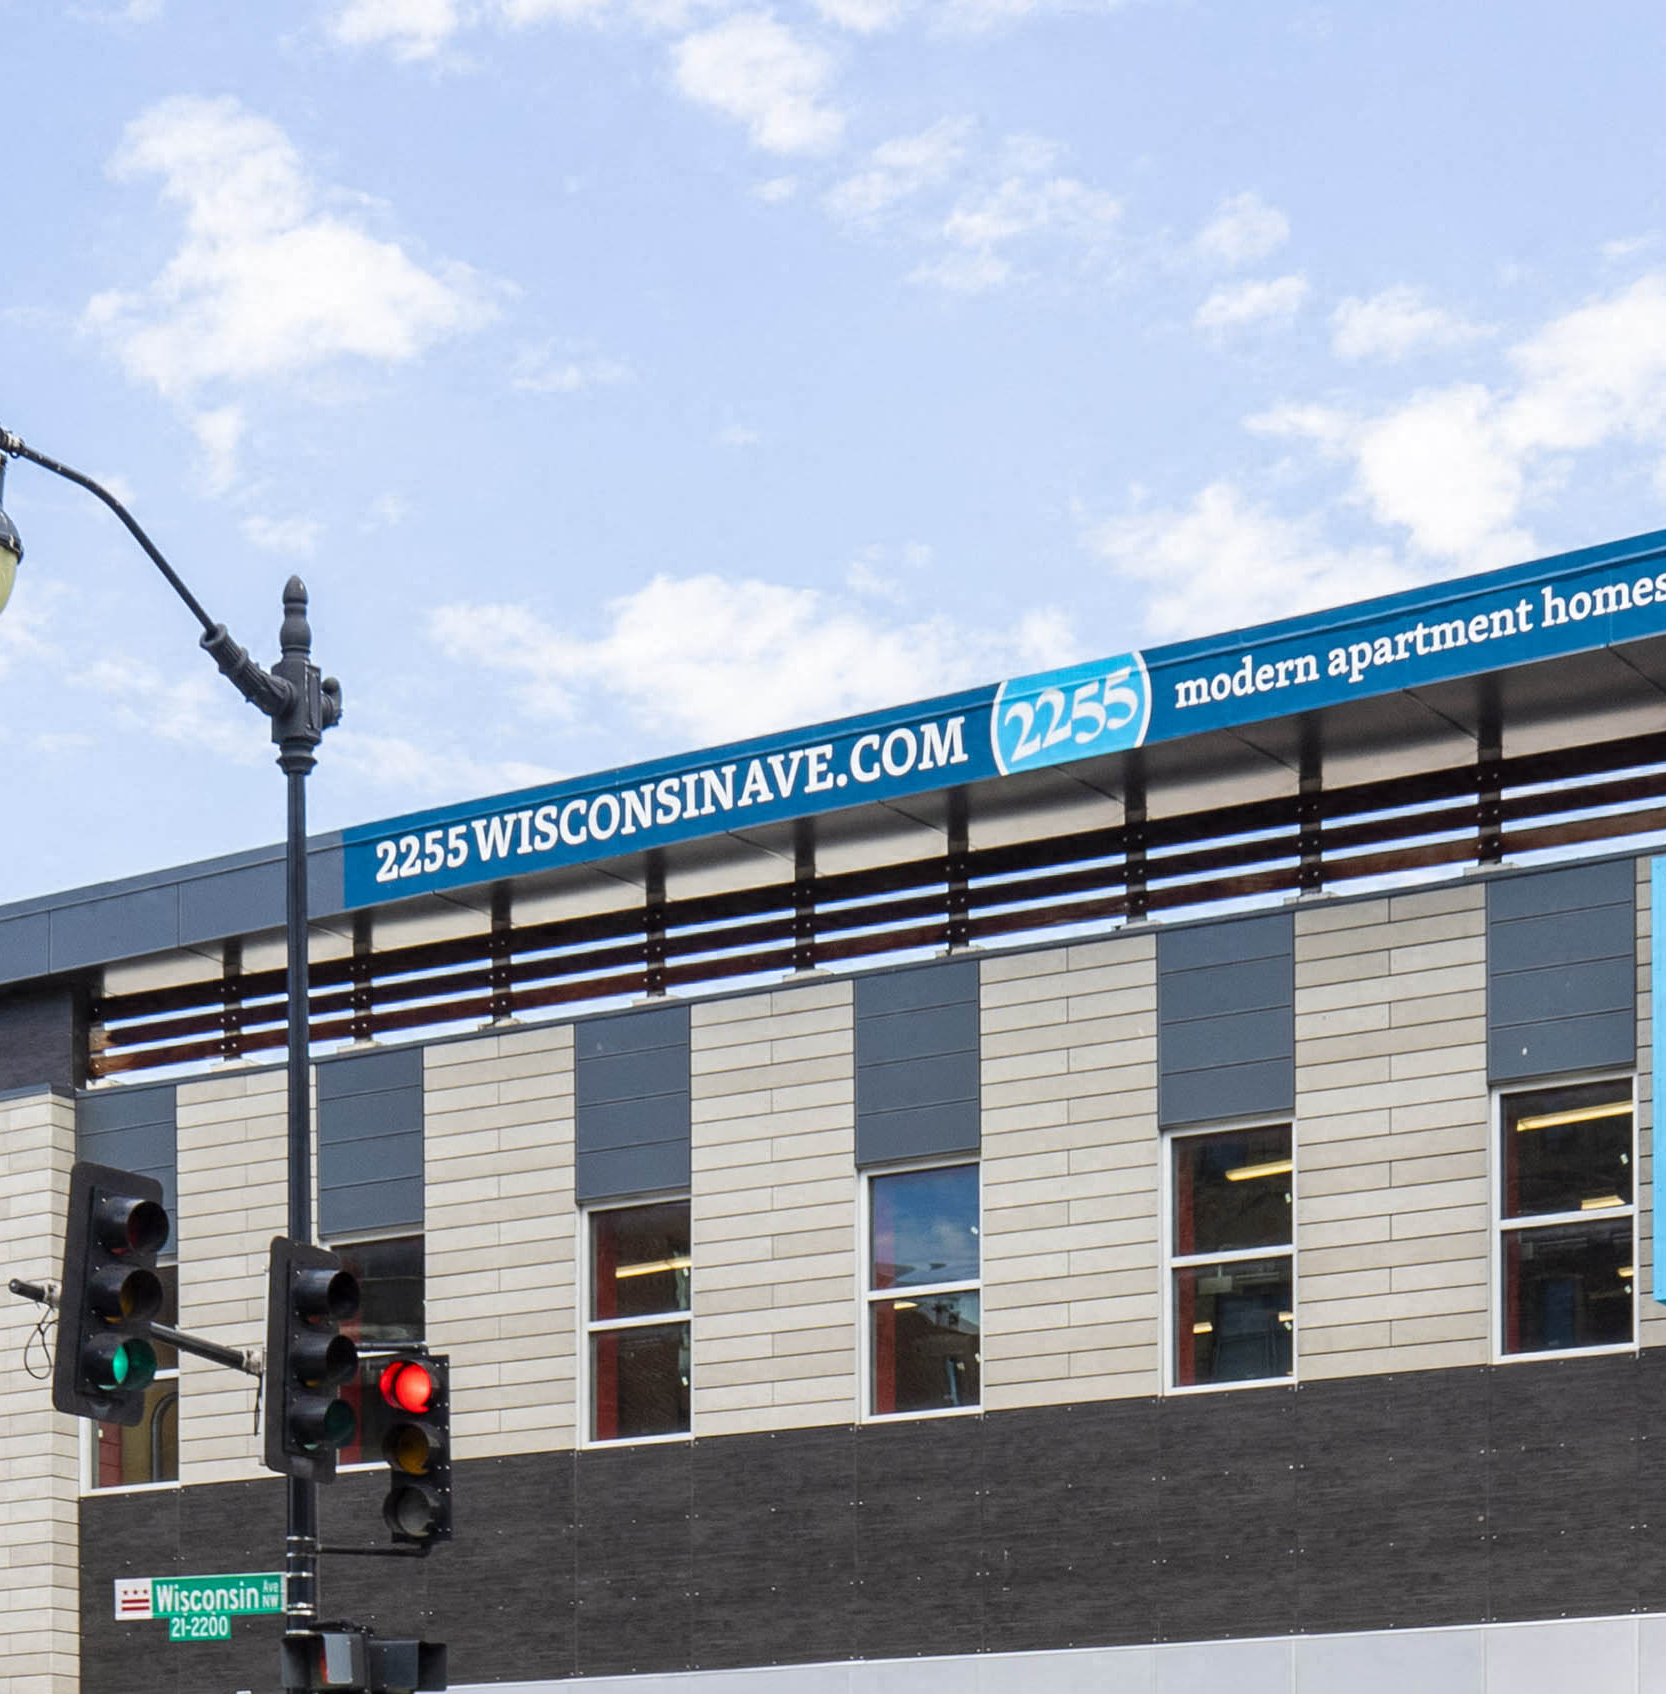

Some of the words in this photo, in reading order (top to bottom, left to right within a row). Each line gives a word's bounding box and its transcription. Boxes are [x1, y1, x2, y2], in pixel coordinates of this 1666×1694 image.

[1175, 654, 1320, 708] modern
[1327, 597, 1534, 689] apartment
[1003, 665, 1140, 762] 2255
[156, 1581, 259, 1612] Wisconsin
[262, 1580, 279, 1593] Ave
[262, 1595, 279, 1608] NW
[171, 1616, 229, 1637] 21-2200
